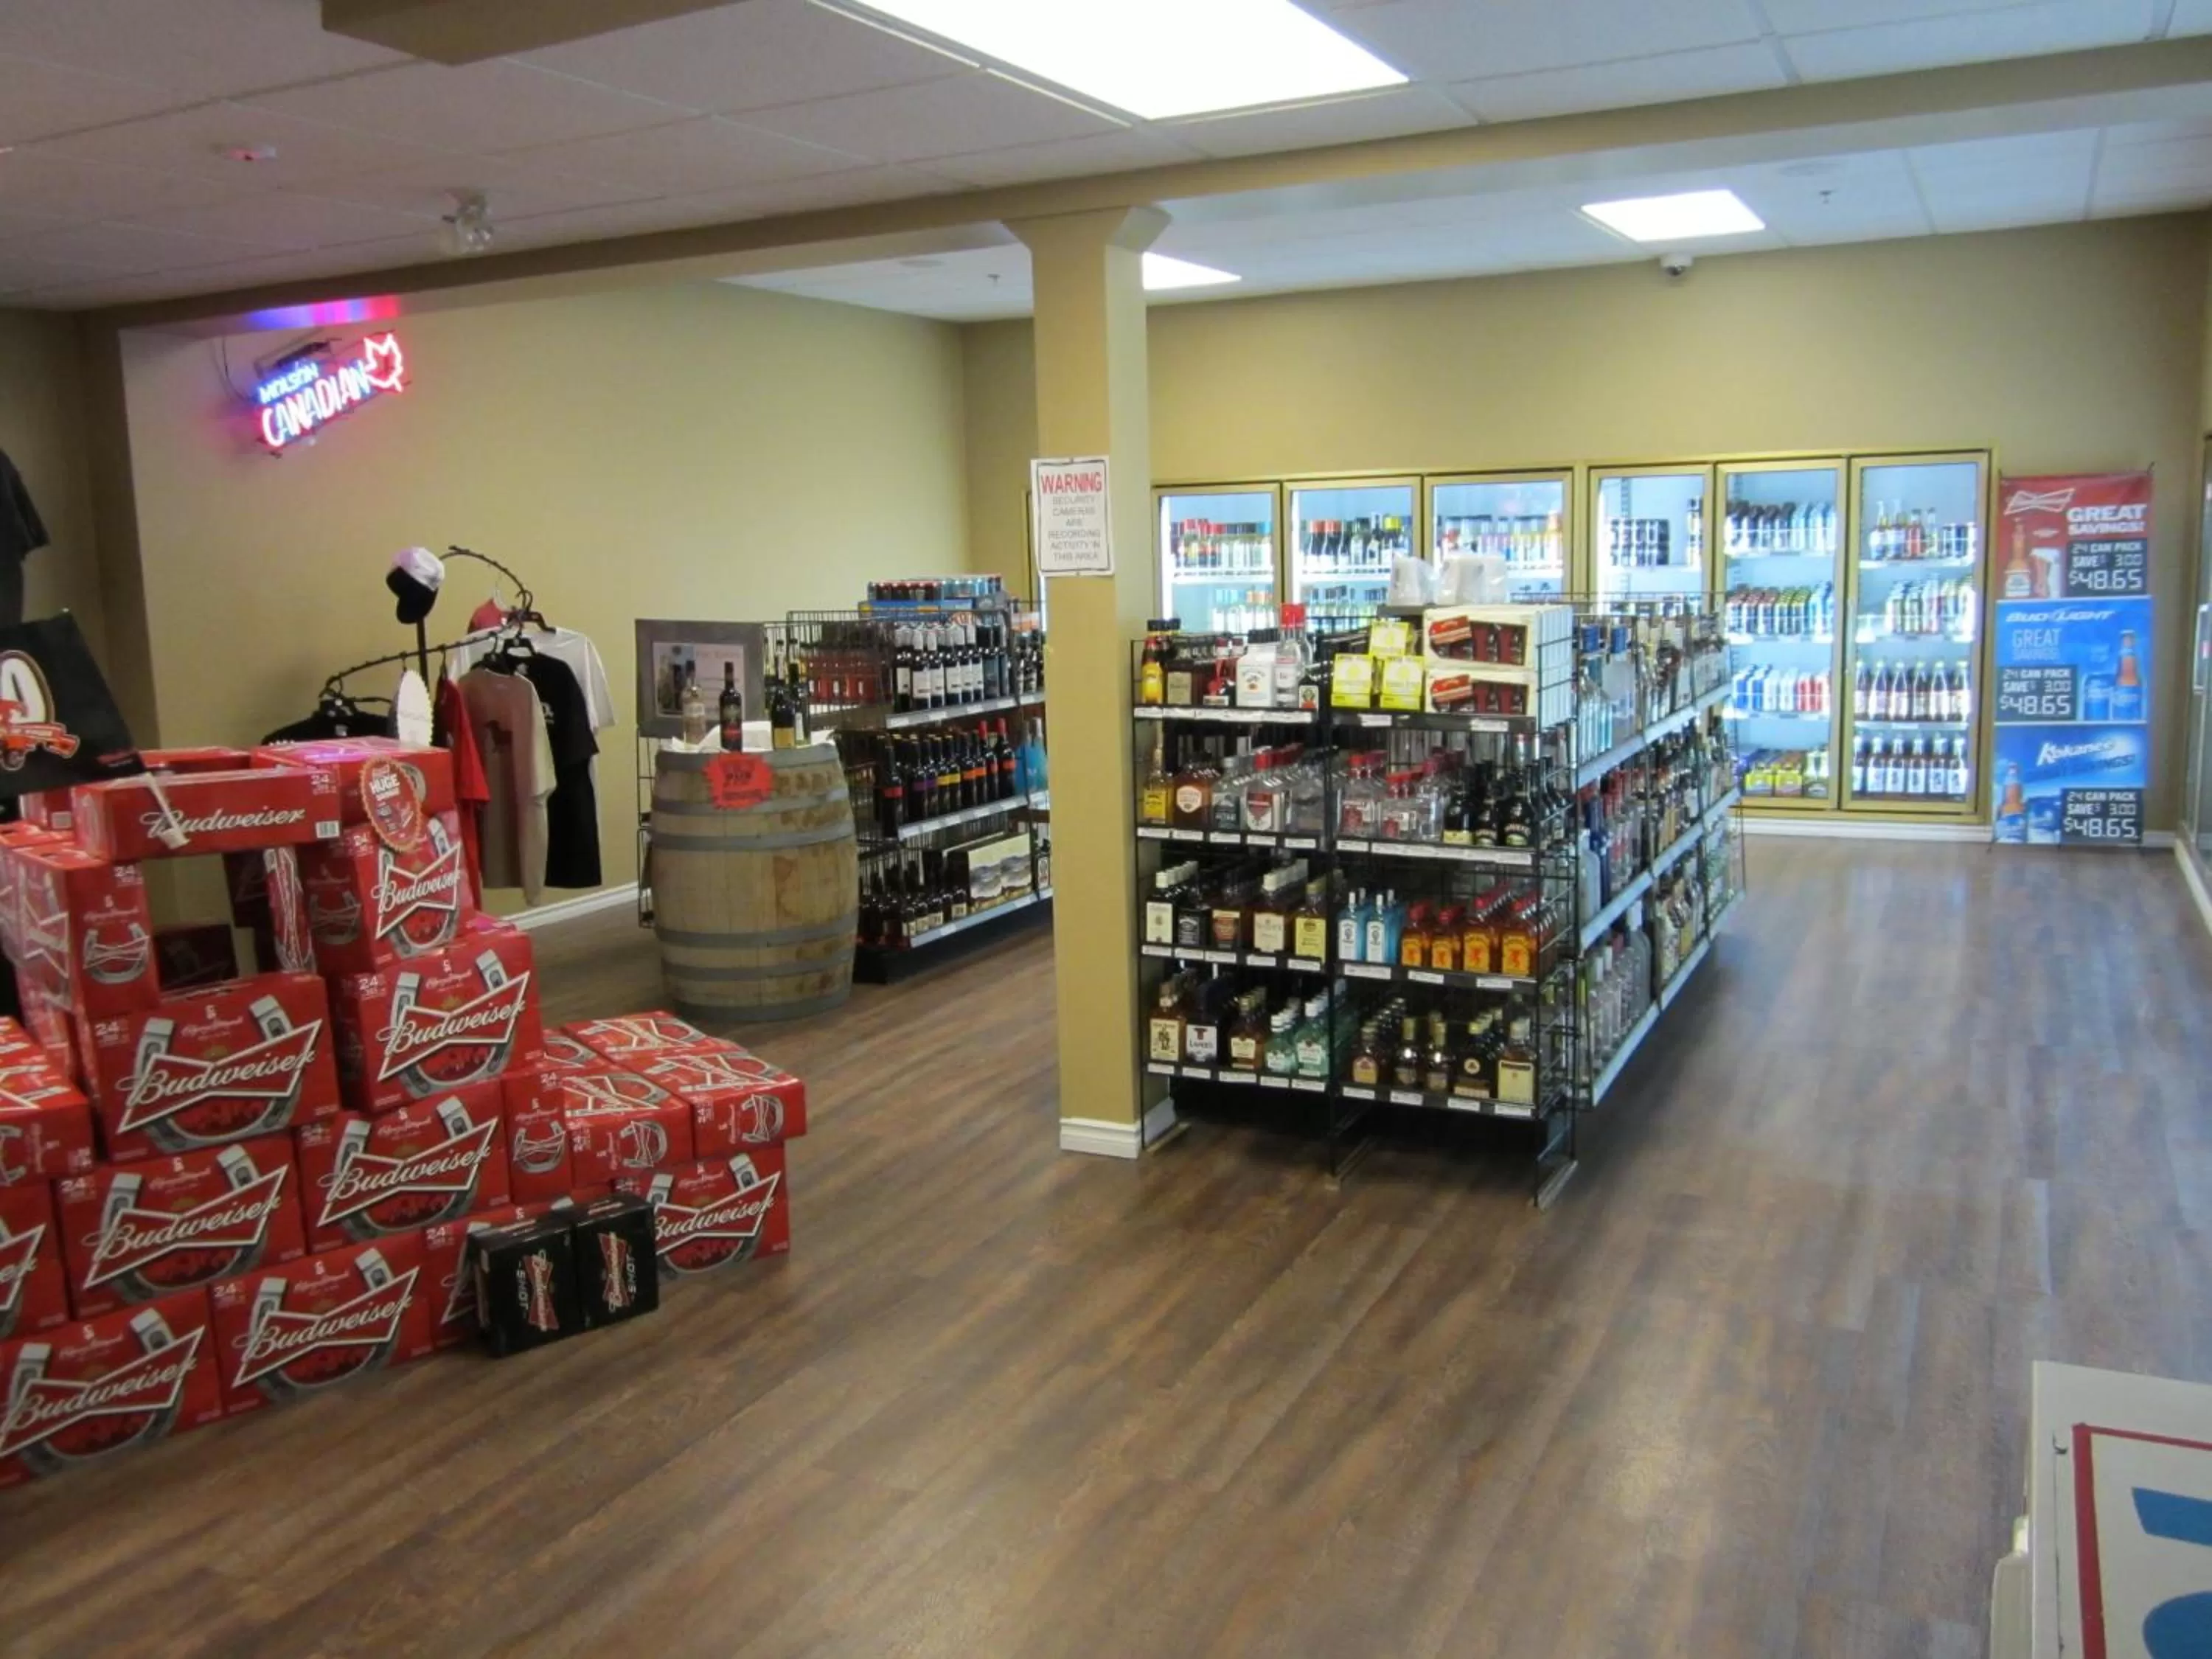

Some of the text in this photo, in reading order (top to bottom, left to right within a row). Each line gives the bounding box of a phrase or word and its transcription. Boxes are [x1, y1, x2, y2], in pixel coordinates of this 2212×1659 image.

[262, 359, 370, 447] CANADIAN
[1041, 472, 1102, 494] WARNING
[2067, 504, 2147, 523] GREAT
[2068, 568, 2143, 591] $48.65
[2012, 628, 2062, 648] GREAT
[1999, 695, 2070, 715] $48.65
[369, 774, 400, 796] HUGE
[139, 806, 305, 839] Budweiser
[2064, 817, 2136, 838] $48.65
[371, 868, 461, 914] Budweiser
[359, 976, 379, 990] 24
[376, 999, 526, 1057] Budweiser
[115, 1048, 316, 1108] Budweiser
[317, 1144, 491, 1204] Budweiser
[82, 1194, 282, 1264] Budweiser
[426, 1227, 446, 1239] 24
[655, 1197, 774, 1241] Budweiser
[232, 1294, 413, 1364] Budweiser
[0, 1355, 198, 1436] Budweiser
